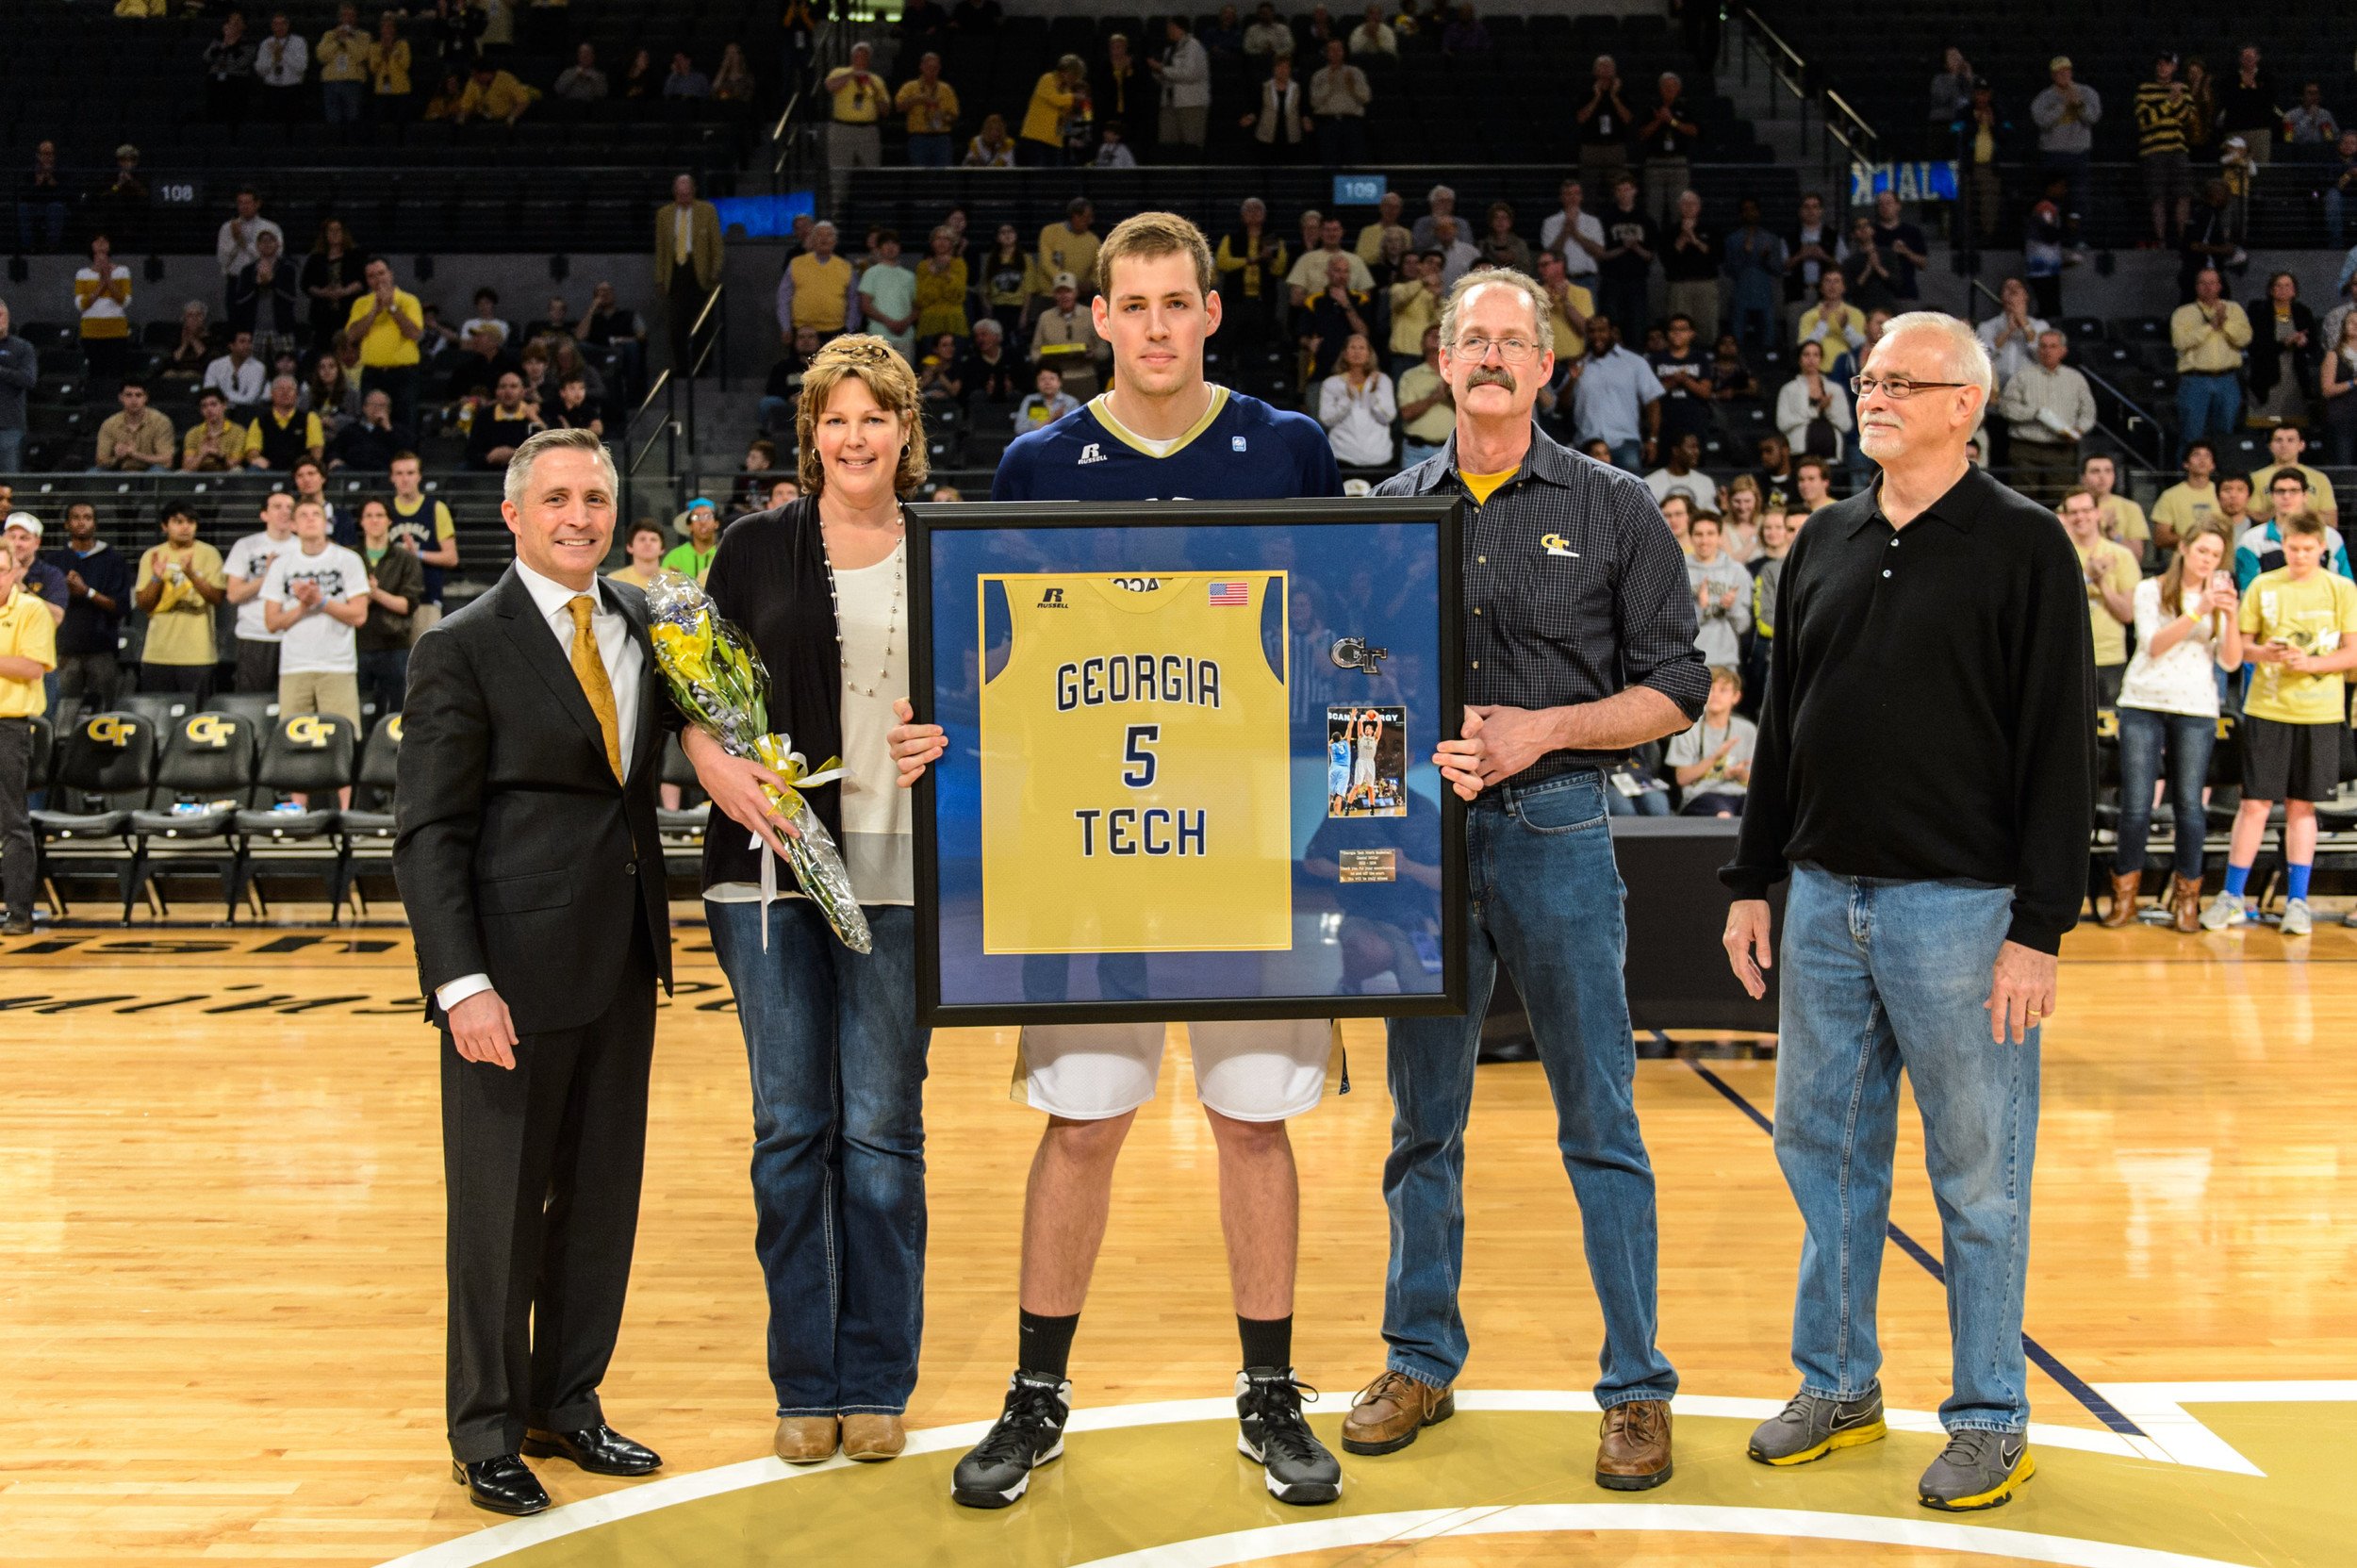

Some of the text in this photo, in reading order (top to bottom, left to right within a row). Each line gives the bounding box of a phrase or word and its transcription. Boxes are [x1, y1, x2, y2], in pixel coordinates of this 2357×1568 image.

[160, 184, 193, 202] 108
[1345, 182, 1377, 198] 109
[1078, 454, 1108, 465] RUSSELL
[1541, 534, 1569, 551] GT
[1330, 636, 1388, 673] GT
[1056, 653, 1222, 712] GEORGIA
[88, 716, 136, 746] GT
[187, 716, 235, 747] GT
[286, 716, 335, 747] GT
[1121, 722, 1161, 789] 5
[1074, 807, 1207, 857] TECH
[0, 935, 401, 954] ish
